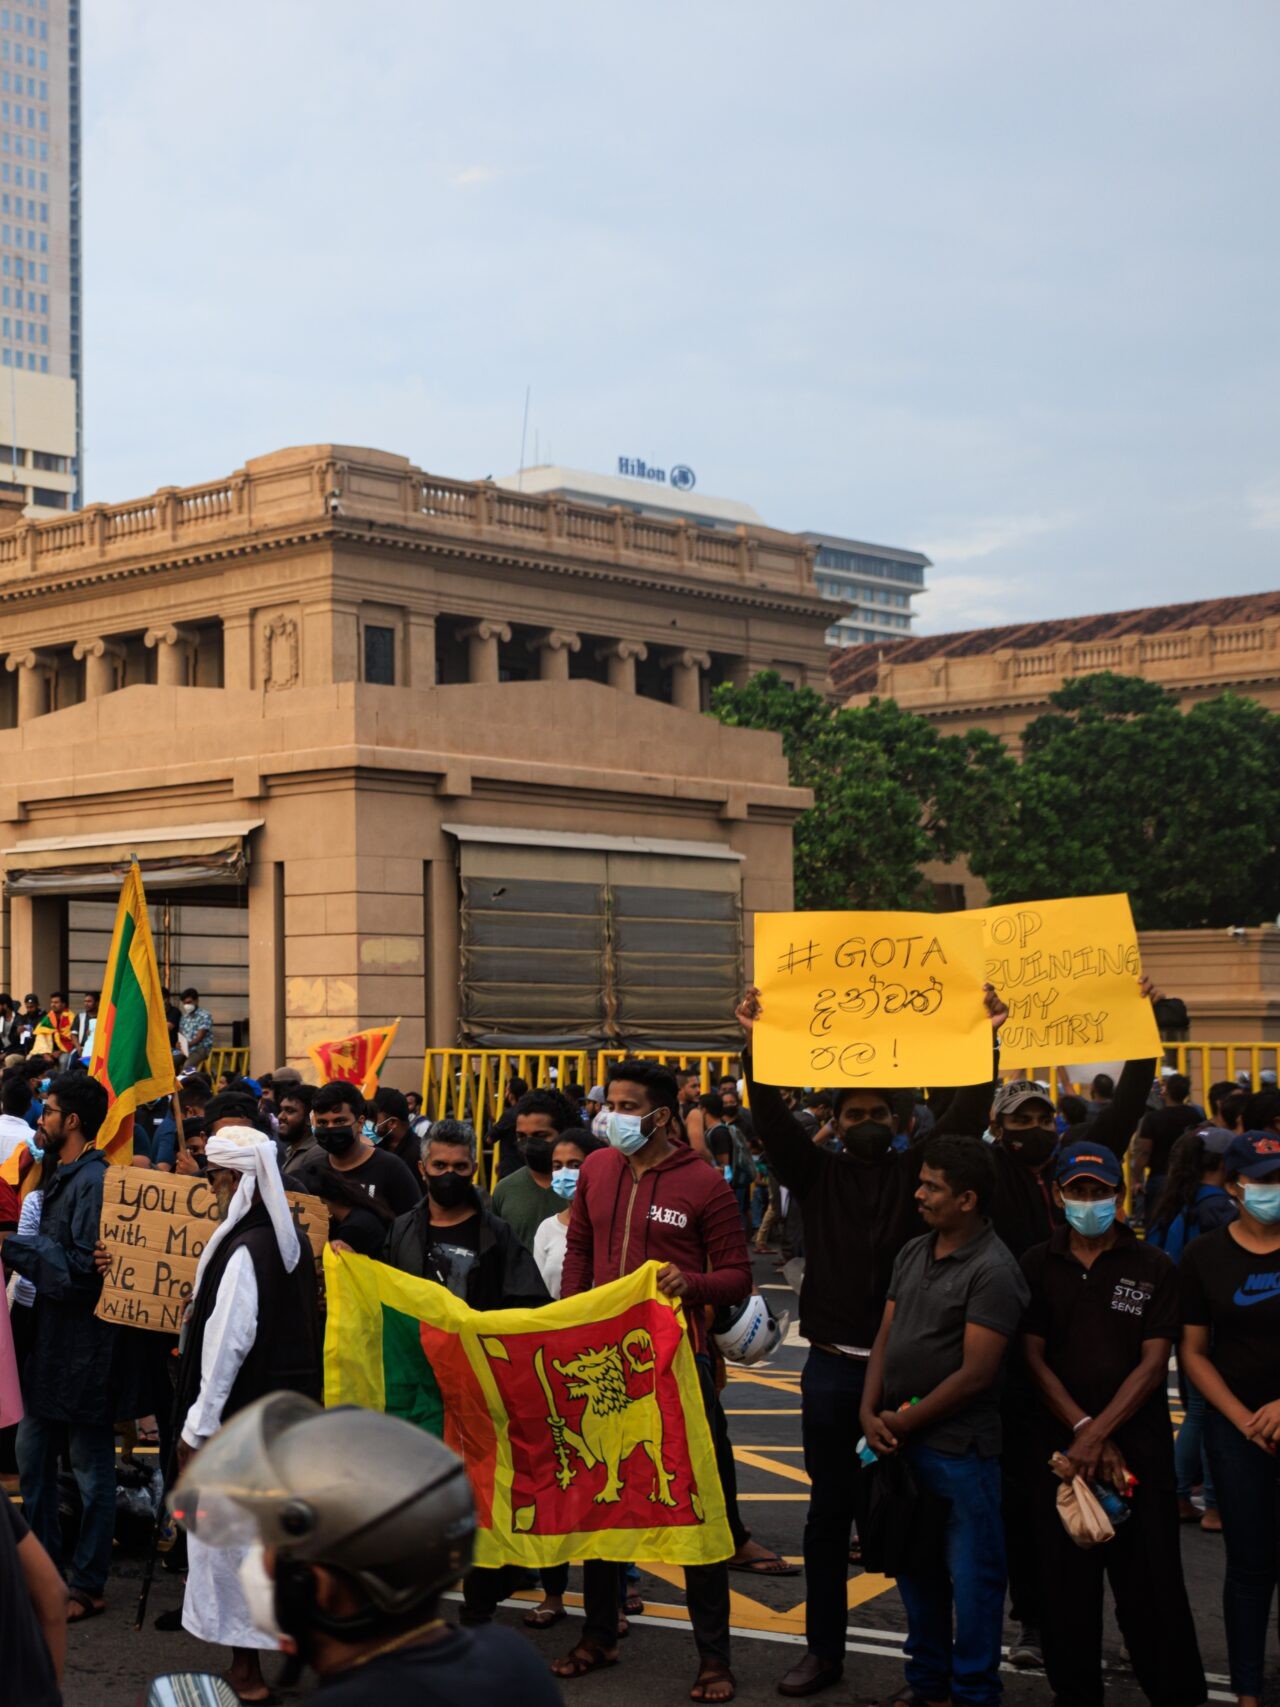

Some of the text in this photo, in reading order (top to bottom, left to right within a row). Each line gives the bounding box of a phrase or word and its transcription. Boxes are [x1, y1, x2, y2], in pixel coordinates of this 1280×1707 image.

[618, 456, 665, 482] Hilton
[777, 936, 948, 975] # GOTA
[985, 945, 1139, 991] RUINING
[1008, 988, 1059, 1020] MY
[999, 1011, 1109, 1049] UNTRY
[165, 1224, 208, 1258] Mo
[153, 1261, 193, 1298] Pro
